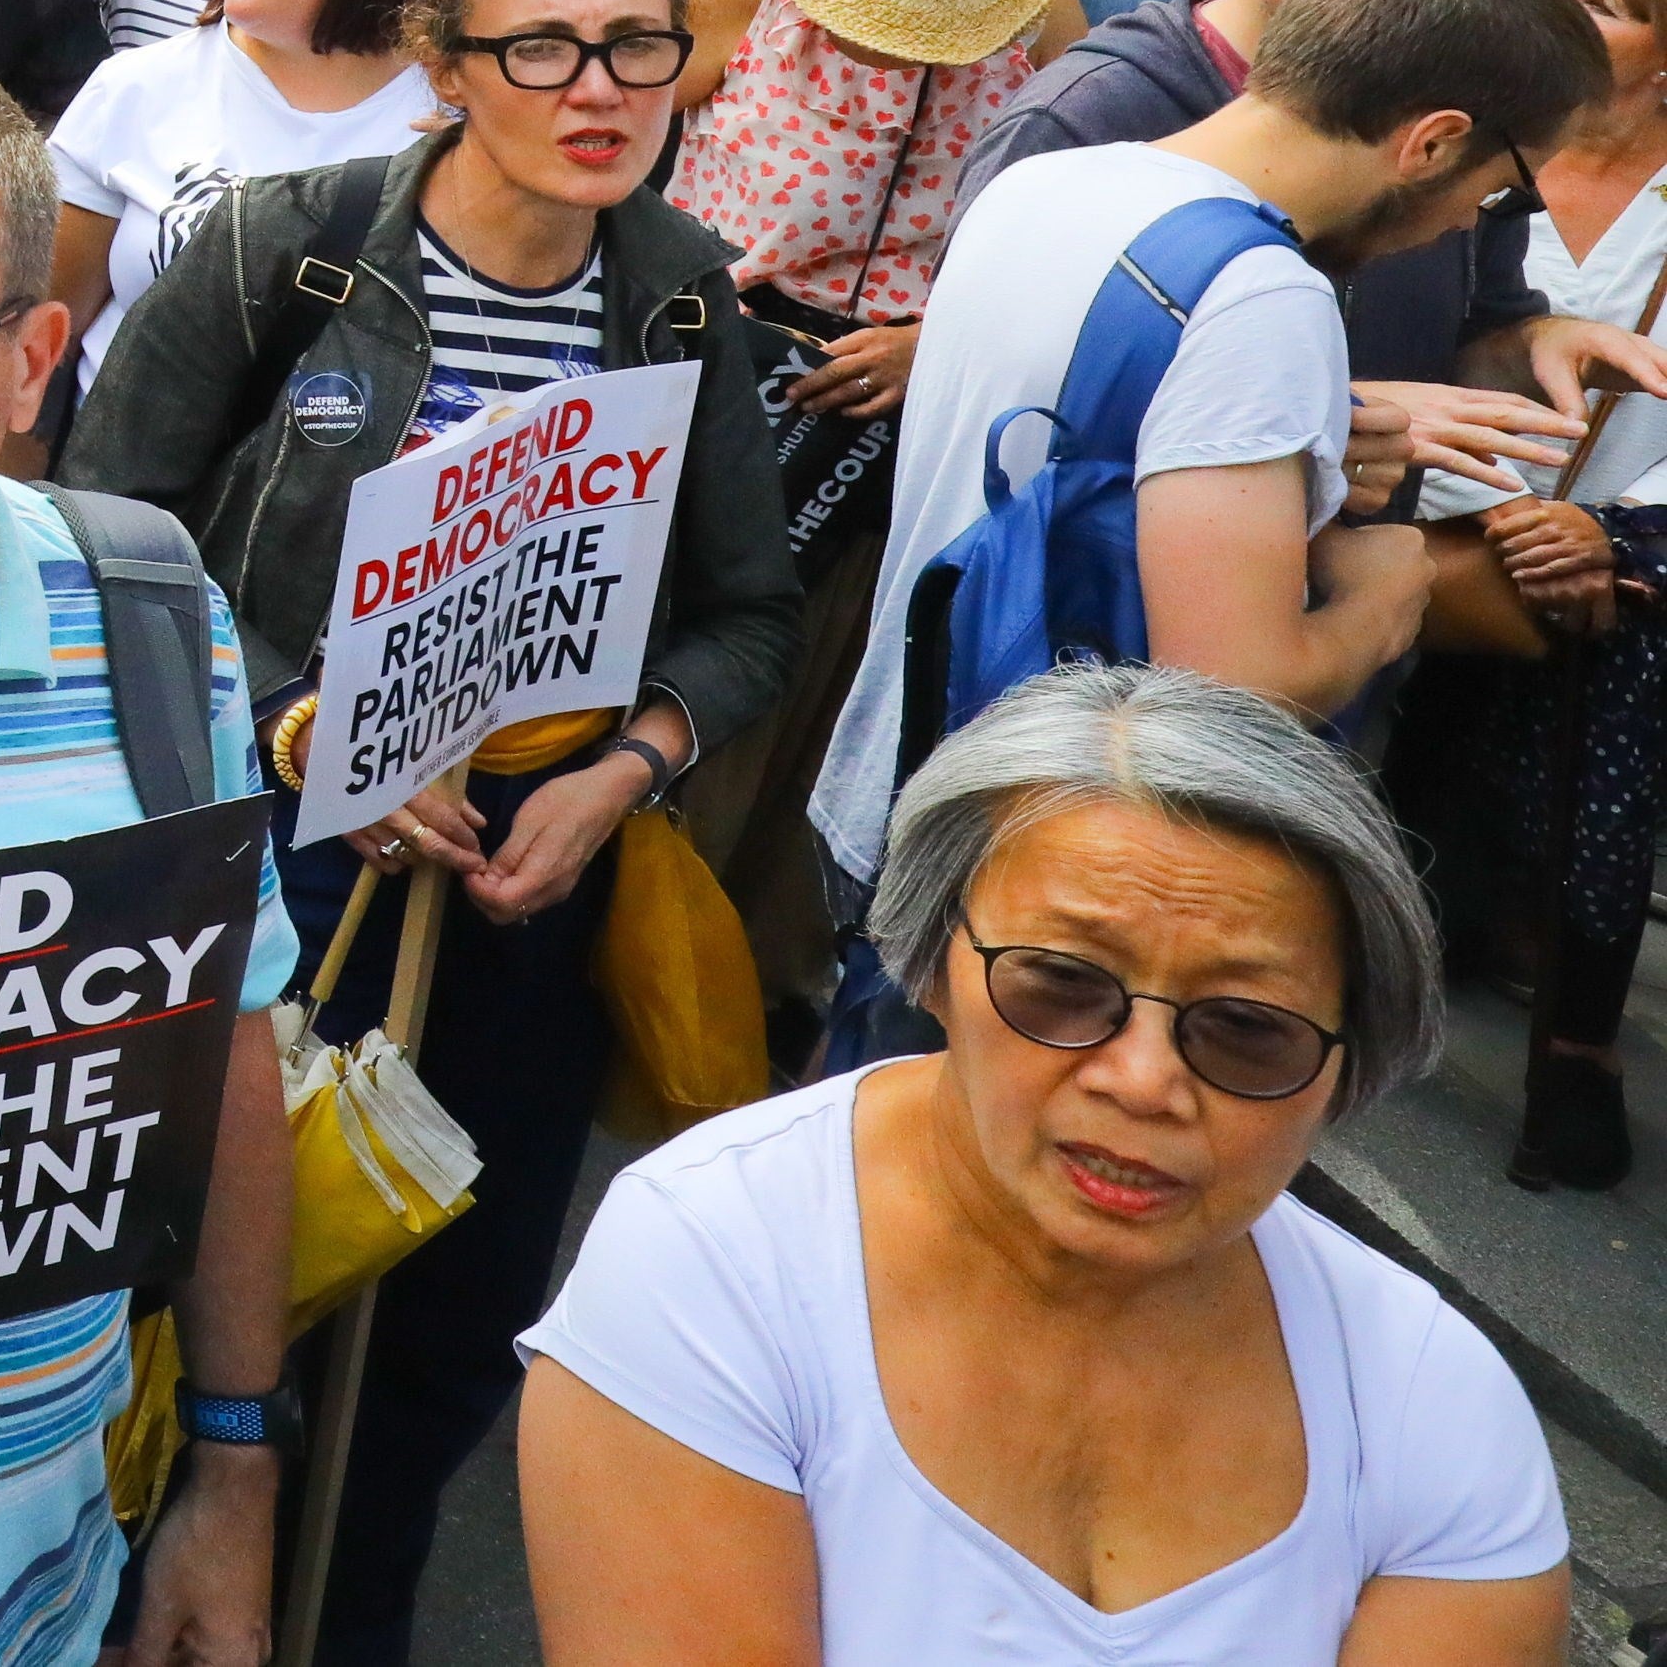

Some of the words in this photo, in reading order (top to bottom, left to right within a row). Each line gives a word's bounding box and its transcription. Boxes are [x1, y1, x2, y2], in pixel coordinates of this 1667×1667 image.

[295, 404, 364, 418] DEMOCRACY
[307, 396, 350, 408] DEFEND
[434, 398, 594, 522] DEFEND
[351, 446, 669, 619] DEMOCRACY
[381, 562, 512, 678] RESIST
[515, 524, 605, 586] THE
[345, 629, 597, 796] SHUTDOWN
[348, 574, 622, 744] PARLIAMENT
